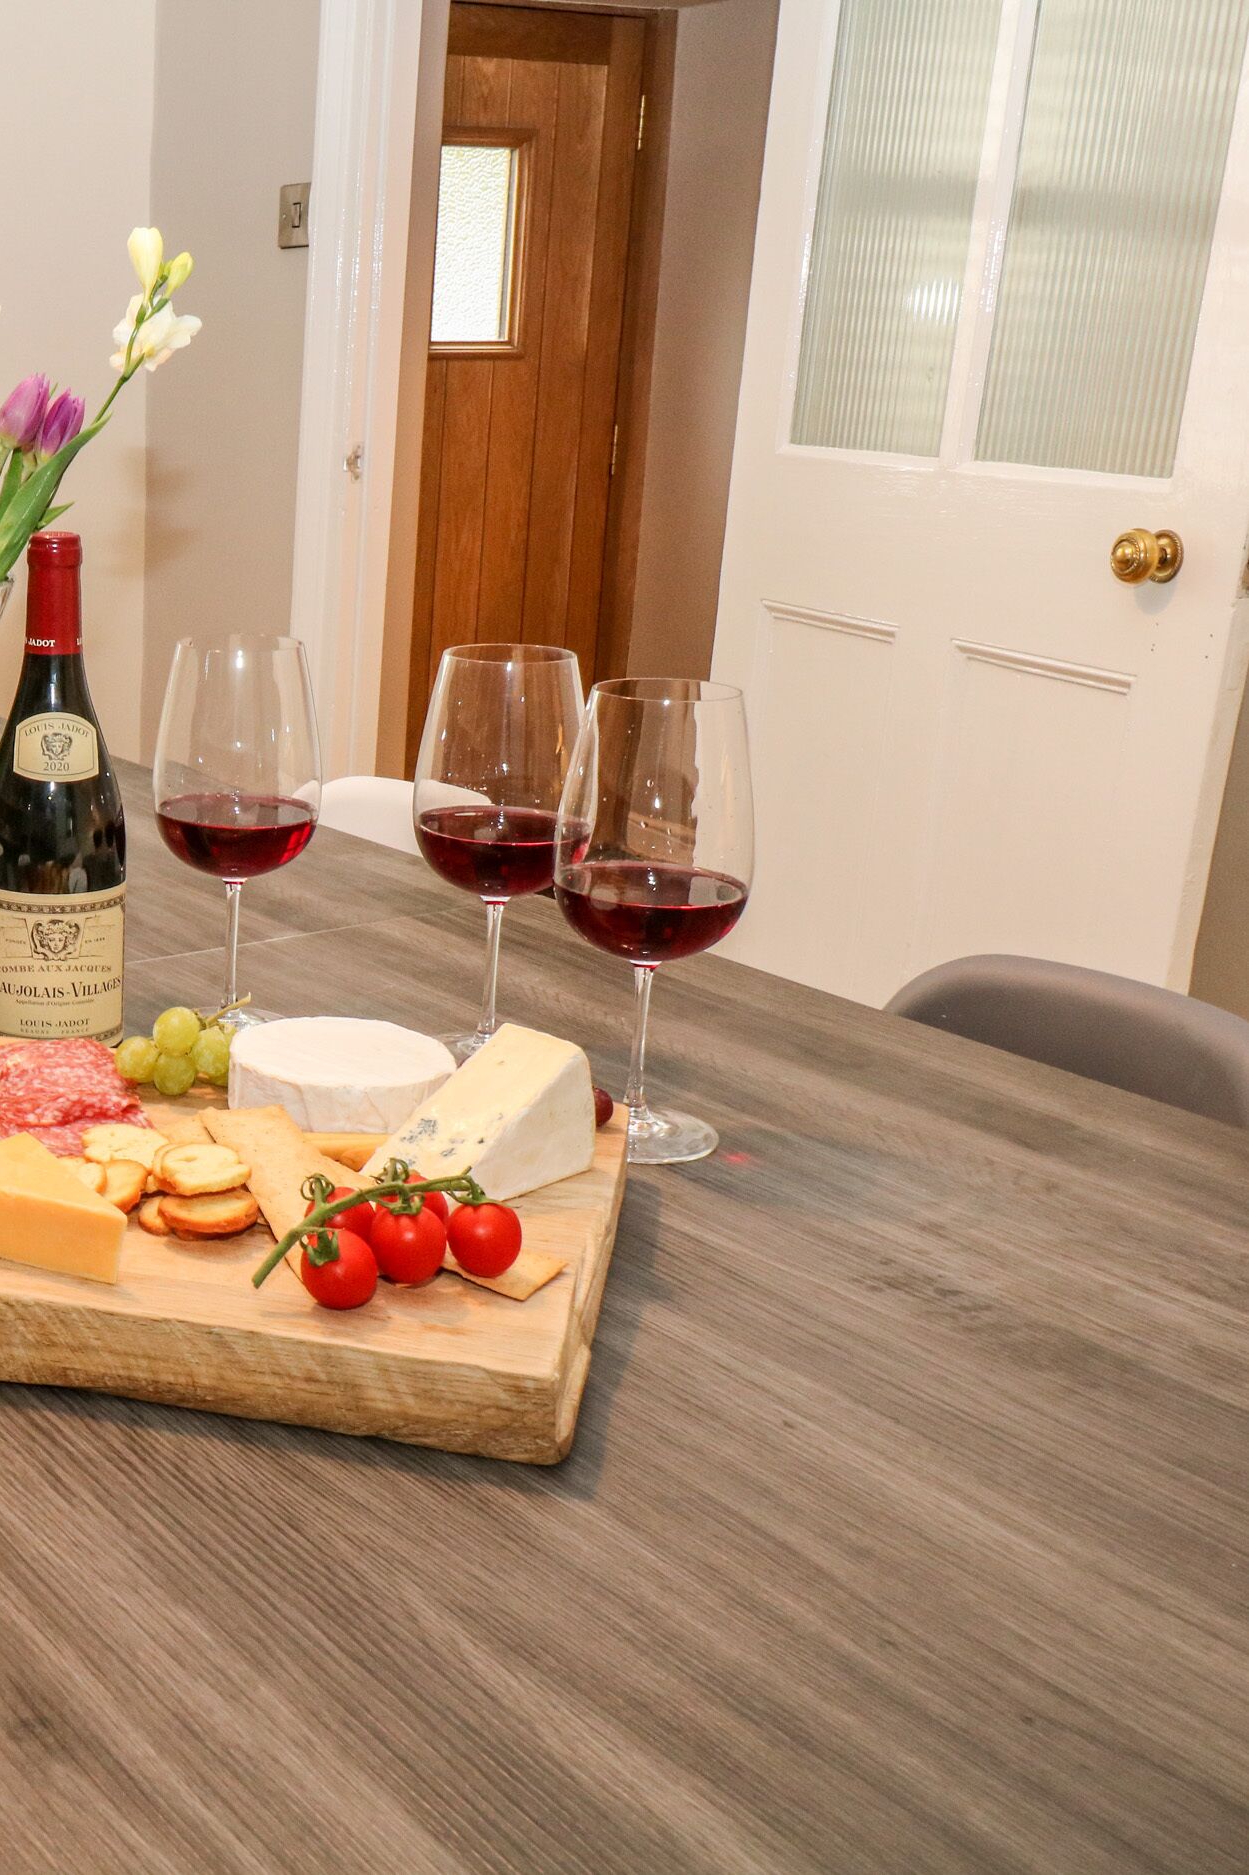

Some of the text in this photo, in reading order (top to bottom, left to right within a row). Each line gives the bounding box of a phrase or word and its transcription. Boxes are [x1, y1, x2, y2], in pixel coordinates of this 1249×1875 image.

[28, 637, 56, 647] JADOT
[24, 722, 89, 738] LOUIS JADOT
[43, 761, 70, 772] 2020
[38, 964, 63, 972] AUX
[65, 964, 112, 973] JACQUES
[20, 1018, 90, 1028] LOUIS JADOT
